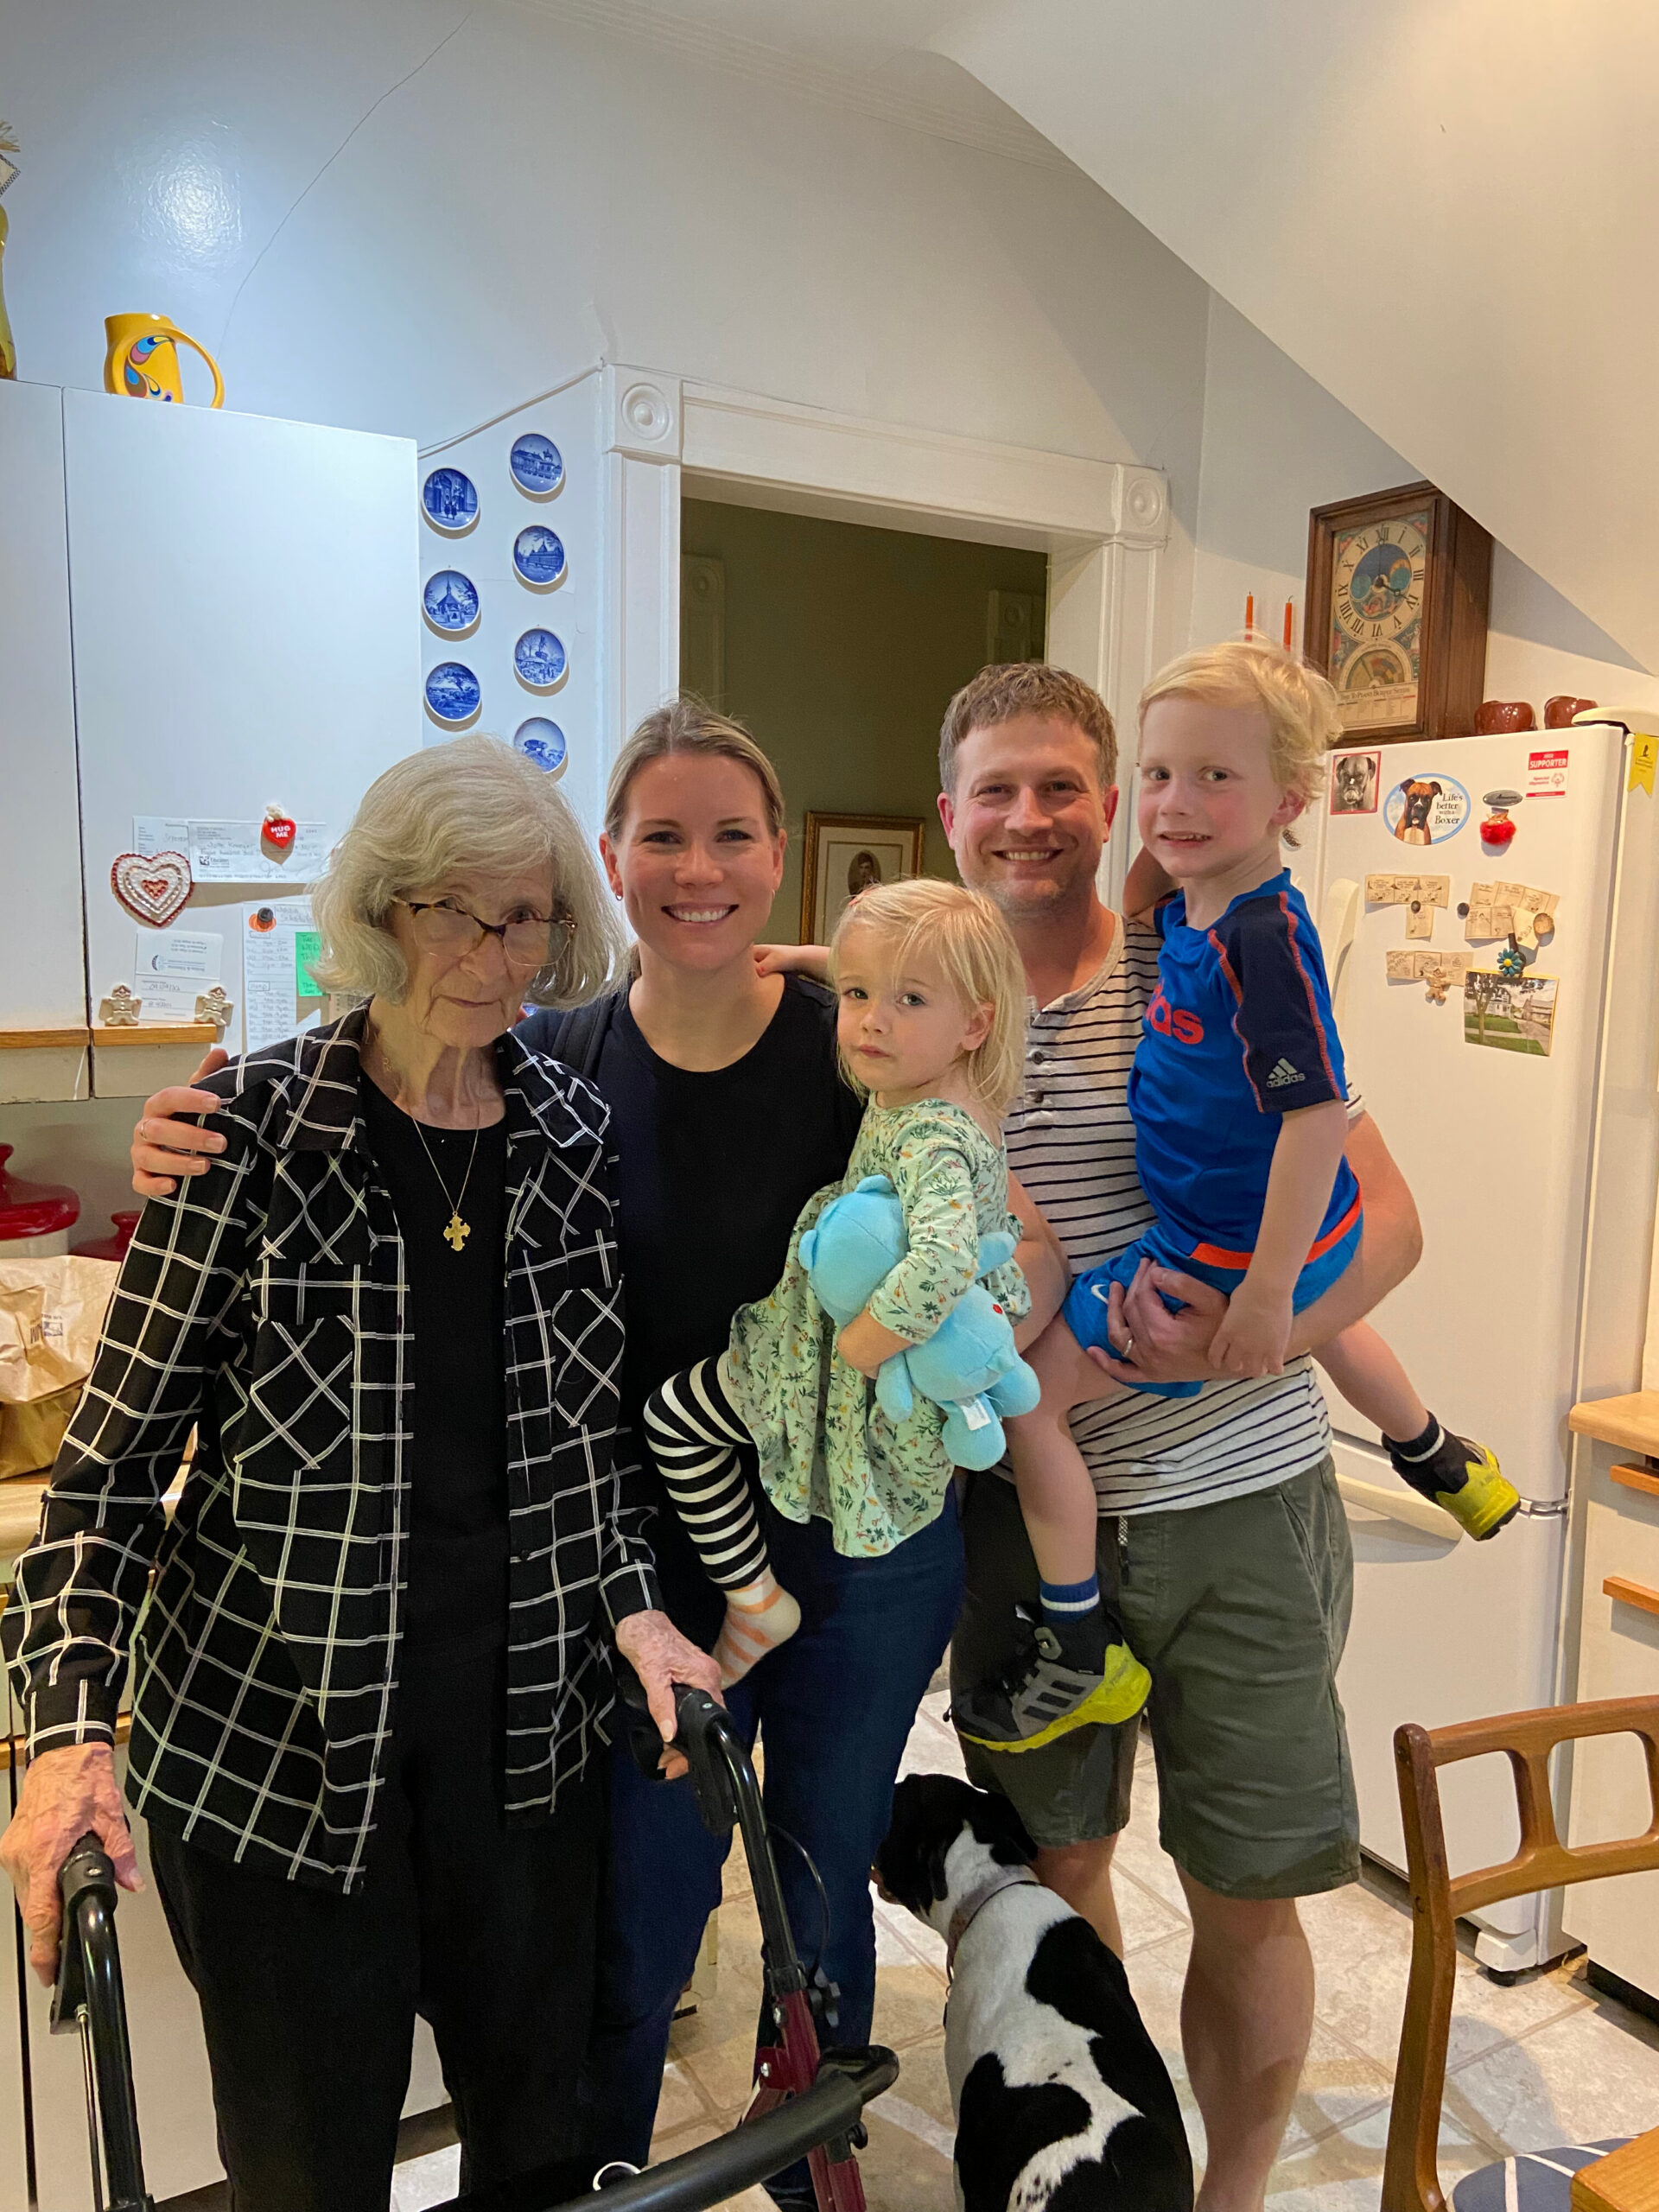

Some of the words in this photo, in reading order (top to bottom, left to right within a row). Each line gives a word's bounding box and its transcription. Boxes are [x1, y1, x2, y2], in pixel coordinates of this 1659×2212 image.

[1529, 758, 1567, 769] SUPPORTER
[1442, 792, 1464, 802] Life's
[1434, 815, 1460, 824] Boxer
[1266, 1072, 1306, 1089] adidas
